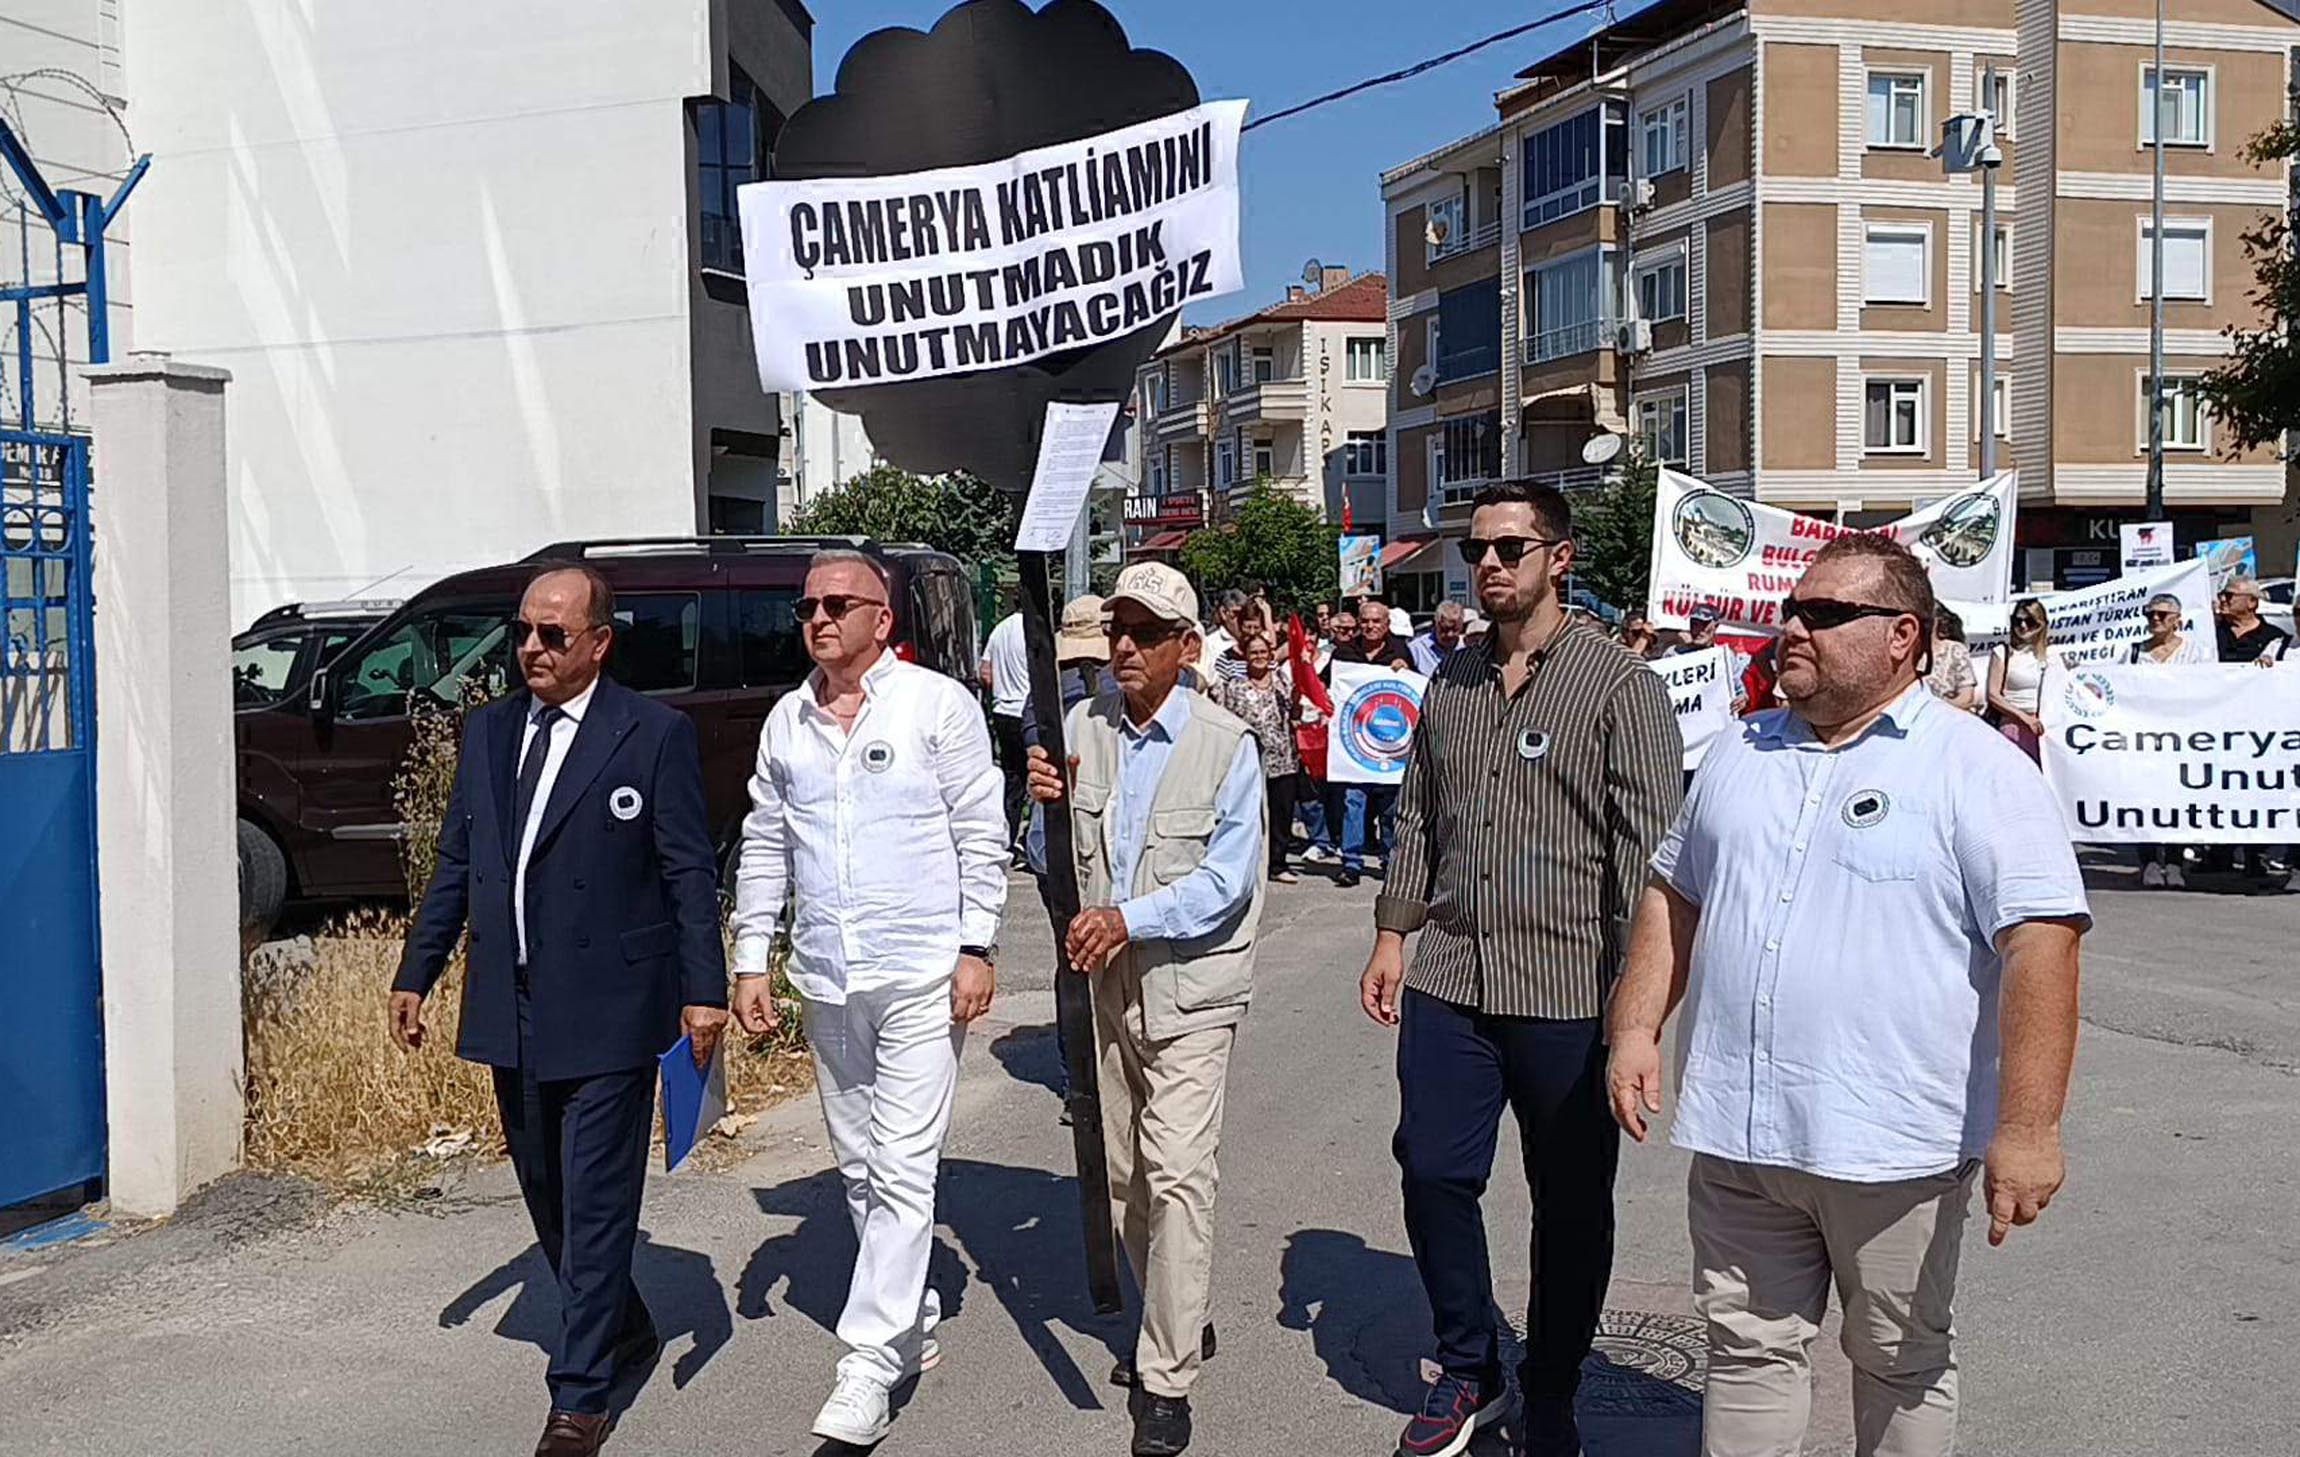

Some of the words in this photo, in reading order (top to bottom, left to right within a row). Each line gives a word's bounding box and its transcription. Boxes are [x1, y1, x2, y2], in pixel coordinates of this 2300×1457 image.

[790, 188, 991, 280] ÇAMERYA
[996, 121, 1213, 246] KATLİAMINI
[847, 220, 1166, 327] UNUTMADIK
[805, 249, 1213, 384] UNUTMAYACAĞIZ
[1750, 599, 1777, 624] VE
[2081, 629, 2100, 643] VE
[2065, 724, 2300, 758] Çamerya
[2076, 800, 2300, 829] Unuttur
